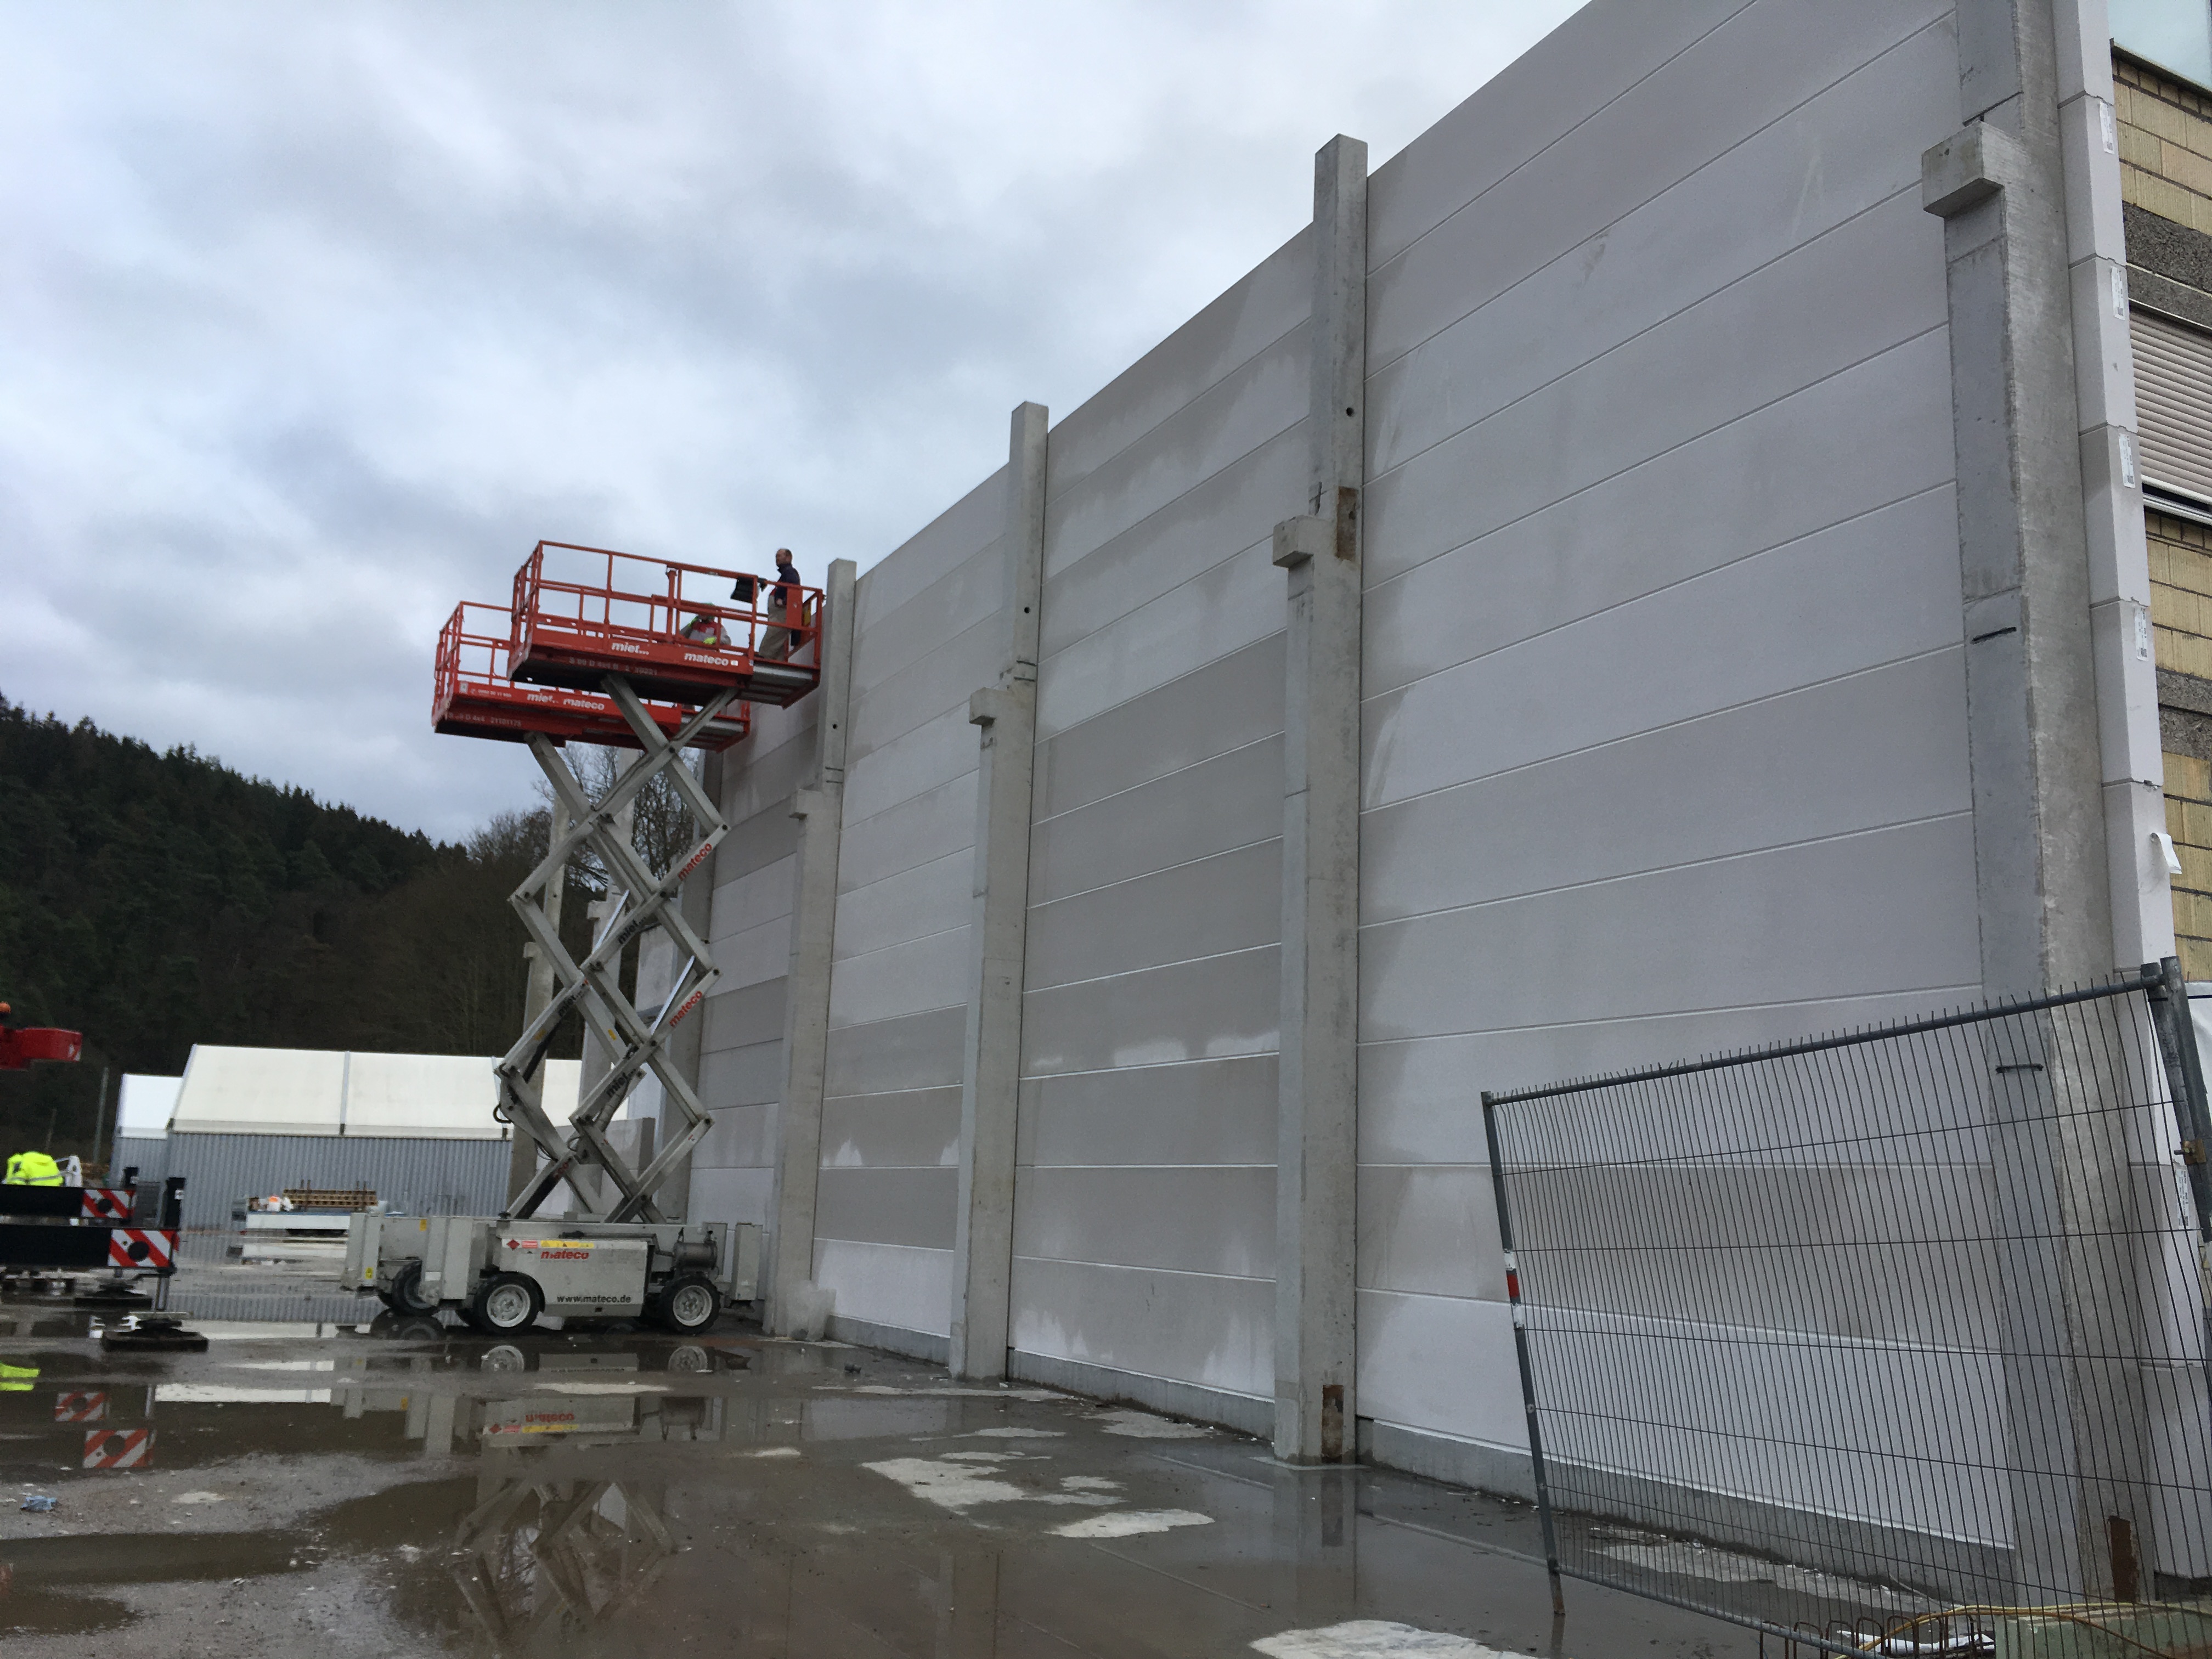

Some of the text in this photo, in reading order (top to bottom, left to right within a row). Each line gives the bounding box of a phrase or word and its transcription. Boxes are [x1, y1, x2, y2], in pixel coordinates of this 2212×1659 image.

[685, 653, 729, 666] mateco
[563, 698, 605, 710] mateco
[678, 843, 713, 881] mateco
[669, 991, 703, 1028] mateco
[540, 1250, 589, 1260] mateco
[557, 1295, 631, 1303] www.mateco.de
